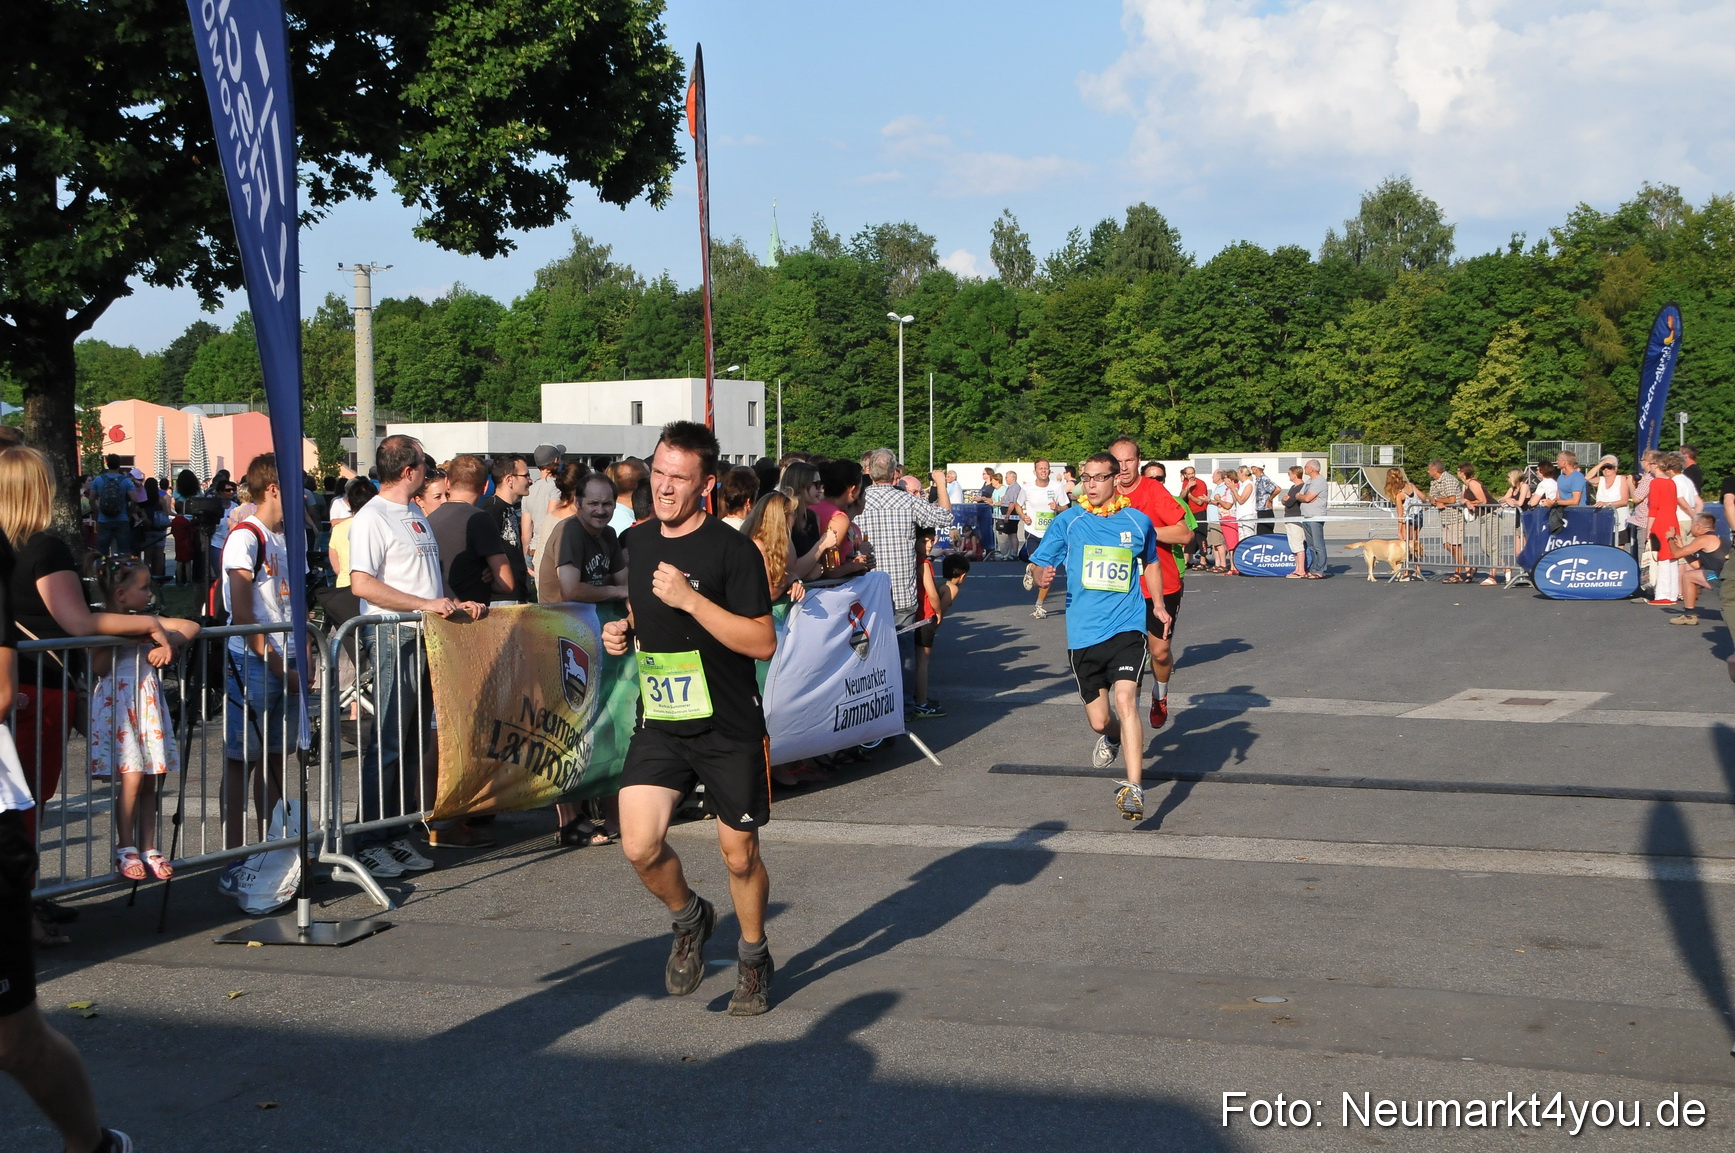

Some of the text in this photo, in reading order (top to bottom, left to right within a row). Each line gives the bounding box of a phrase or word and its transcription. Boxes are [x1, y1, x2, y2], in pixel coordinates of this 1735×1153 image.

[1252, 551, 1296, 563] Fische
[1085, 560, 1129, 581] 1165
[1560, 568, 1628, 582] Fischer
[1566, 581, 1623, 589] AUTOMOBILE
[647, 676, 691, 703] 317
[844, 667, 887, 698] Neumarkter
[833, 687, 895, 733] Lammsbräu
